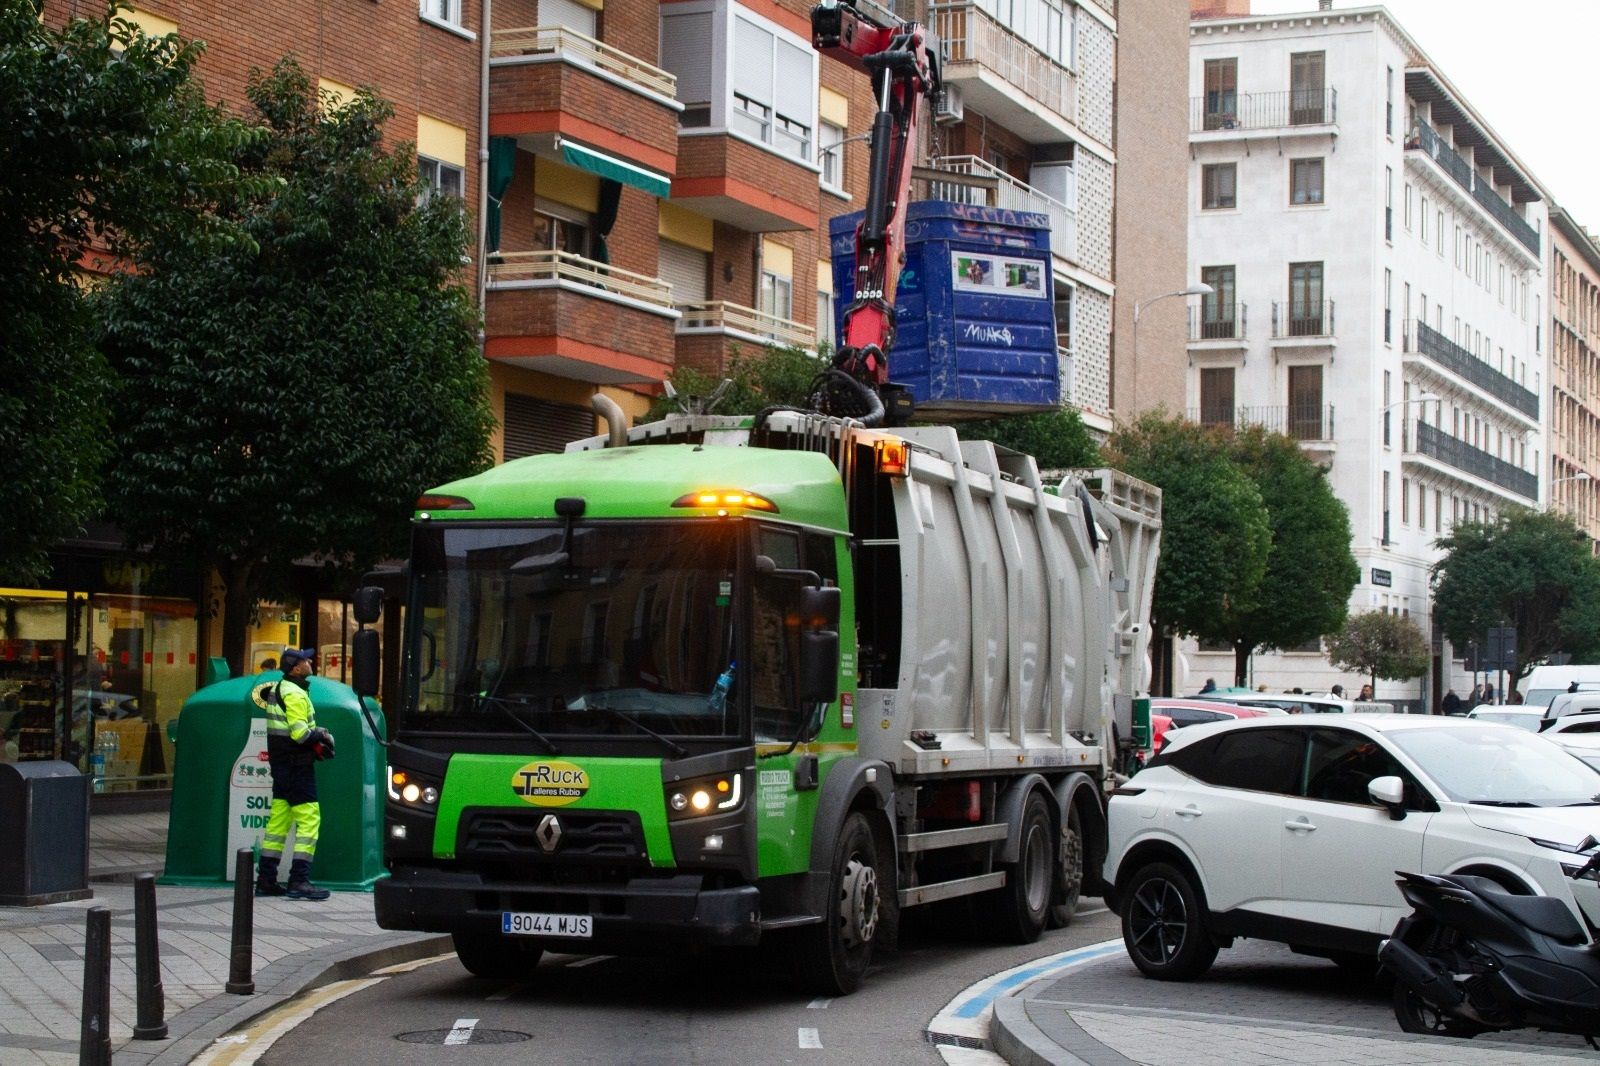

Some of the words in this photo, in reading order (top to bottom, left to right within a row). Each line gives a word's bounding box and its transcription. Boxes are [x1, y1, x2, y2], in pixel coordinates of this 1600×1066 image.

[520, 765, 584, 796] TRUCK
[559, 787, 581, 796] Rubio
[513, 915, 553, 933] 9044
[558, 916, 588, 934] MJS
